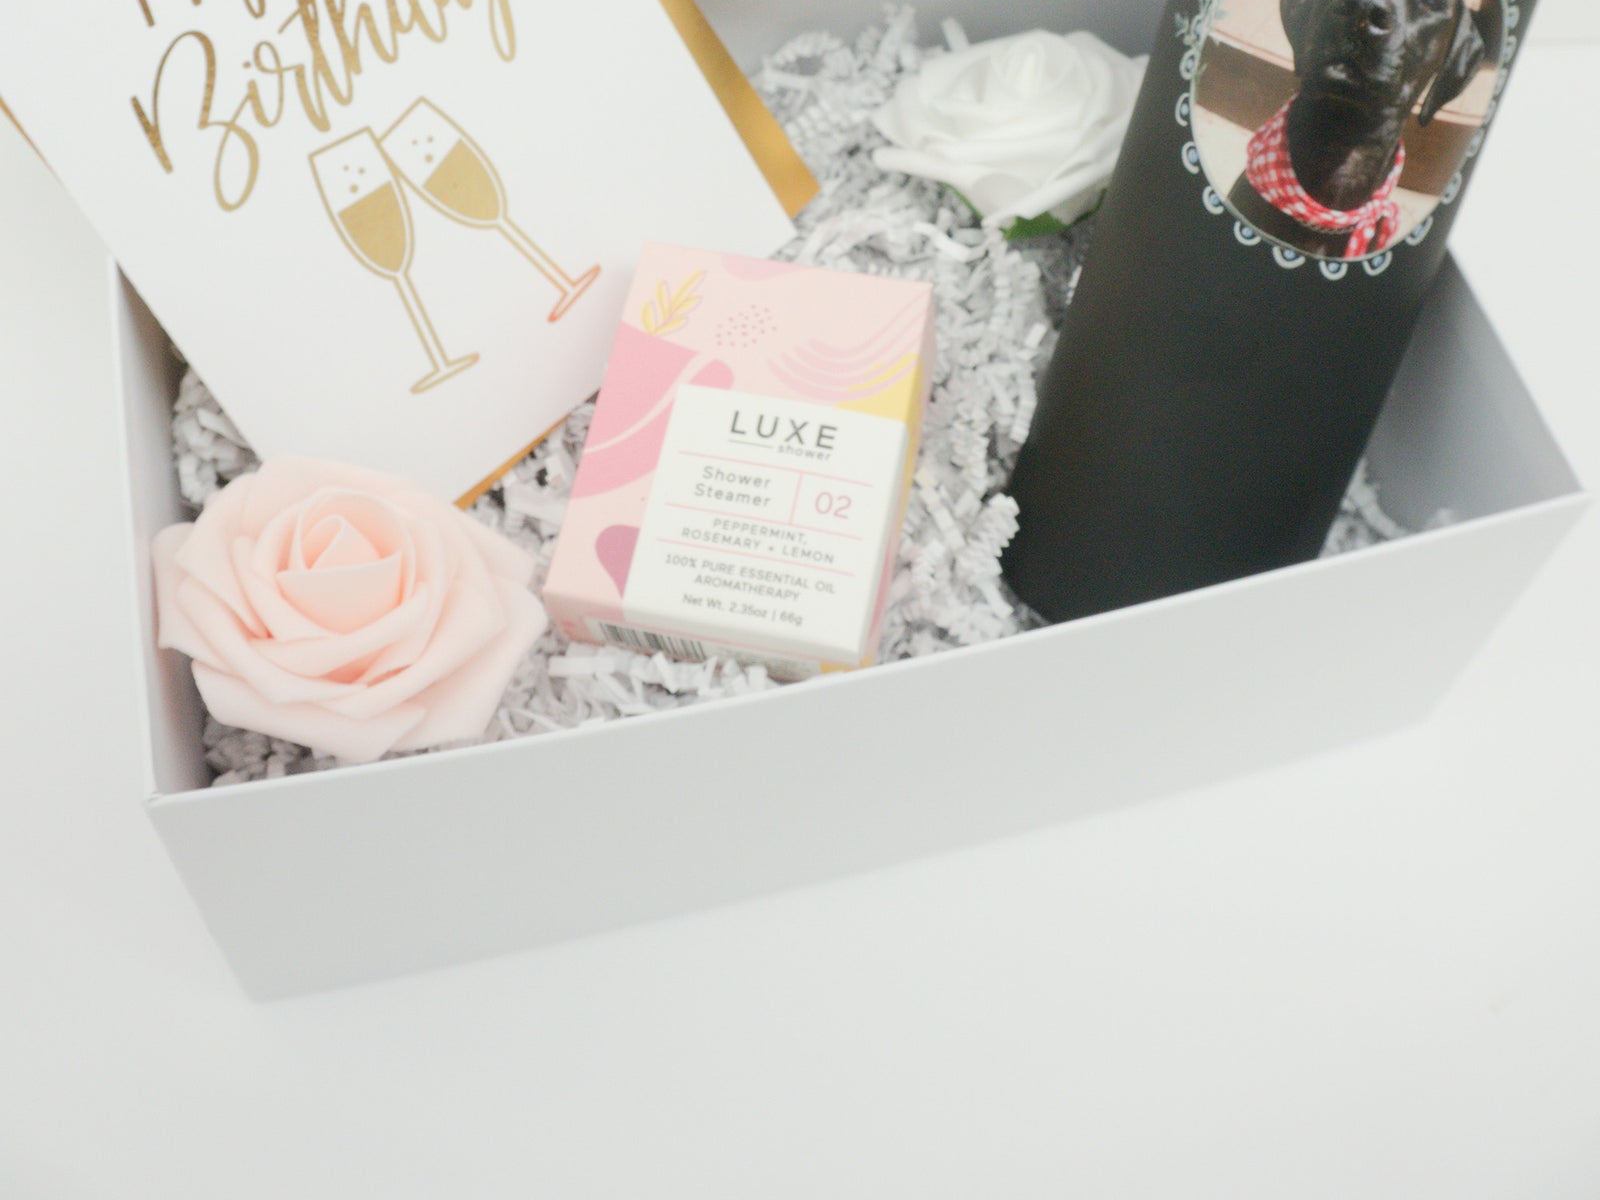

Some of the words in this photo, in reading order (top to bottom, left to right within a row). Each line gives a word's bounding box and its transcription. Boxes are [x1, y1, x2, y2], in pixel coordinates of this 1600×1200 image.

[730, 410, 838, 450] LUXE
[777, 443, 832, 462] shower
[702, 465, 772, 489] Shower
[694, 483, 772, 508] Steamer
[814, 491, 853, 520] 02
[712, 517, 808, 545] PEPPERMINT,
[680, 527, 761, 550] ROSEMARY
[782, 545, 836, 565] LEMON
[664, 553, 697, 569] 100%
[701, 560, 735, 575] PURE
[739, 566, 809, 589] ESSENTIAL
[815, 580, 836, 595] OIL
[693, 574, 801, 602] AROMATHERAPY
[682, 593, 703, 607] Net
[706, 596, 724, 611] Wt.
